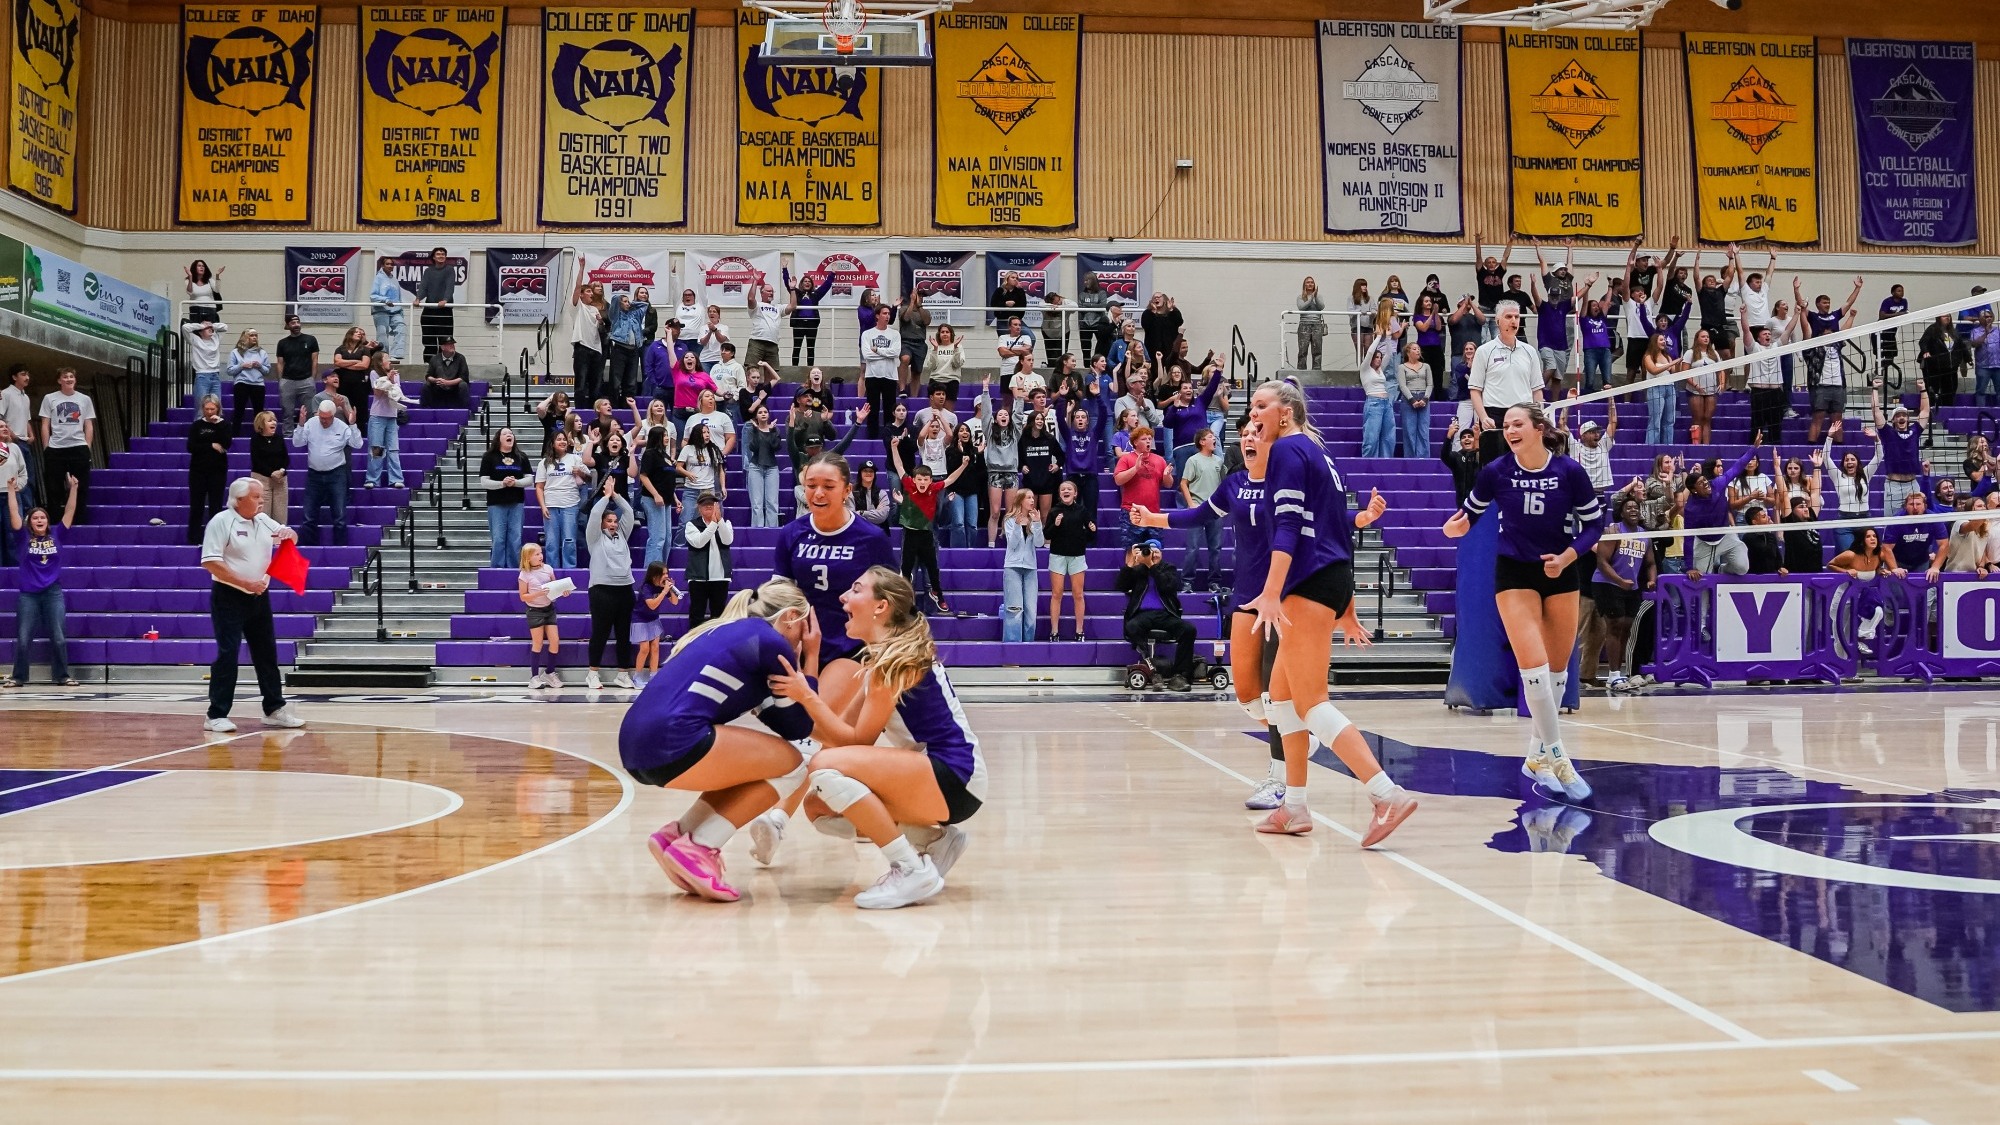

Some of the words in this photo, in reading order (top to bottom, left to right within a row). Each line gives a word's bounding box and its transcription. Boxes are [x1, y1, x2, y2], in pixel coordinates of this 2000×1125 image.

[186, 9, 241, 23] COLLEGE
[252, 9, 267, 23] OF
[278, 9, 315, 23] IDAHO
[370, 9, 427, 22] COLLEGE
[433, 9, 450, 22] OF
[457, 9, 495, 23] IDAHO
[546, 12, 613, 32] COLLEGE
[617, 12, 638, 32] OF
[643, 12, 690, 32] IDAHO
[938, 14, 1008, 30] ALBERTSON
[1023, 16, 1076, 31] COLLEGE
[26, 5, 65, 66] NAIA
[1322, 22, 1395, 37] ALBERTSON
[1401, 25, 1457, 39] COLLEGE
[1508, 34, 1578, 50] ALBERTSON
[1584, 37, 1638, 51] COLLEGE
[1688, 40, 1756, 56] ALBERTSON
[1761, 43, 1814, 58] COLLEGE
[1850, 43, 1916, 59] ALBERTSON
[1921, 45, 1972, 60] COLLEGE
[982, 56, 1031, 71] CASCADE
[1364, 56, 1415, 71] CASCADE
[211, 50, 291, 95] NAIA
[391, 53, 471, 95] NAIA
[1551, 69, 1598, 85] CASCADE
[579, 62, 660, 105] NAIA
[959, 82, 1054, 97] COLLEGIATE
[1730, 76, 1776, 91] CASCADE
[1889, 74, 1936, 91] CASCADE
[1346, 83, 1437, 99] COLLEGIATE
[18, 83, 51, 120] DISTRICT
[57, 105, 73, 131] TWO
[974, 104, 1036, 122] CONFERENCE
[1531, 97, 1618, 115] COLLEGIATE
[1713, 104, 1794, 120] COLLEGIATE
[1362, 105, 1423, 124] CONFERENCE
[18, 110, 70, 156] BASKETBALL
[198, 127, 251, 141] DISTRICT
[265, 128, 292, 142] TWO
[382, 127, 440, 141] DISTRICT
[450, 127, 479, 141] TWO
[1546, 118, 1606, 139] CONFERENCE
[1727, 125, 1782, 145] CONFERENCE
[1887, 121, 1944, 143] CONFERENCE
[558, 132, 628, 154] DISTRICT
[638, 135, 671, 155] TWO
[740, 131, 796, 146] CASCADE
[802, 131, 879, 147] BASKETBALL
[22, 138, 65, 177] CHAMPIONS
[203, 143, 286, 157] BASKETBALL
[383, 143, 477, 157] BASKETBALL
[762, 147, 856, 167] CHAMPIONS
[1383, 143, 1457, 158] BASKETBALL
[211, 160, 279, 174] CHAMPIONS
[395, 159, 466, 173] CHAMPIONS
[560, 154, 667, 176] BASKETBALL
[948, 157, 981, 171] NAIA
[989, 156, 1046, 171] DIVISION
[1051, 157, 1062, 171] II
[1359, 157, 1426, 173] CHAMPIONS
[1513, 155, 1577, 170] TOURNAMENT
[1583, 158, 1639, 172] CHAMPIONS
[1702, 164, 1759, 177] TOURNAMENT
[1764, 165, 1811, 177] CHAMPIONS
[1879, 156, 1954, 171] VOLLEYBALL
[805, 168, 812, 179] &
[971, 174, 1038, 189] NATIONAL
[1865, 172, 1888, 187] CCC
[1894, 172, 1967, 188] TOURNAMENT
[34, 172, 52, 198] 1986
[567, 176, 659, 197] CHAMPIONS
[746, 180, 791, 200] NAIA
[805, 180, 853, 201] FINAL
[861, 181, 872, 201] 8
[1343, 181, 1372, 196] NAIA
[1379, 181, 1428, 198] DIVISION
[1435, 184, 1443, 198] II
[192, 188, 228, 202] NAIA
[238, 188, 272, 202] FINAL
[285, 188, 293, 201] 8
[380, 188, 424, 202] NAIA
[428, 187, 465, 202] FINAL
[470, 189, 480, 202] 8
[967, 191, 1043, 206] CHAMPIONS
[1534, 191, 1564, 206] NAIA
[1568, 191, 1602, 207] FINAL
[1607, 193, 1619, 207] 16
[229, 203, 257, 217] 1988
[415, 203, 446, 217] 1989
[595, 198, 632, 218] 1991
[1359, 196, 1427, 213] RUNNER-UP
[1718, 195, 1747, 211] NAIA
[1751, 194, 1782, 211] FINAL
[1786, 198, 1797, 212] 16
[1886, 198, 1908, 208] NAIA
[1912, 198, 1943, 208] REGION
[788, 202, 827, 222] 1993
[990, 207, 1021, 222] 1996
[1380, 212, 1407, 227] 2001
[1893, 210, 1943, 220] CHAMPIONS
[1561, 213, 1592, 228] 2003
[1745, 215, 1775, 231] 2014
[1903, 222, 1934, 237] 2005
[310, 252, 336, 260] 2019-20
[822, 253, 862, 268] SOCCER
[300, 276, 345, 292] CCC
[501, 277, 546, 293] CCC
[99, 303, 118, 314] SERVICES
[138, 299, 149, 311] Go
[132, 308, 155, 325] Yotes!
[1510, 477, 1559, 490] YOTES
[1523, 491, 1545, 515] 16
[1249, 503, 1257, 526] 1
[797, 543, 855, 560] YOTES
[811, 564, 829, 591] 3
[1729, 591, 1790, 653] Y
